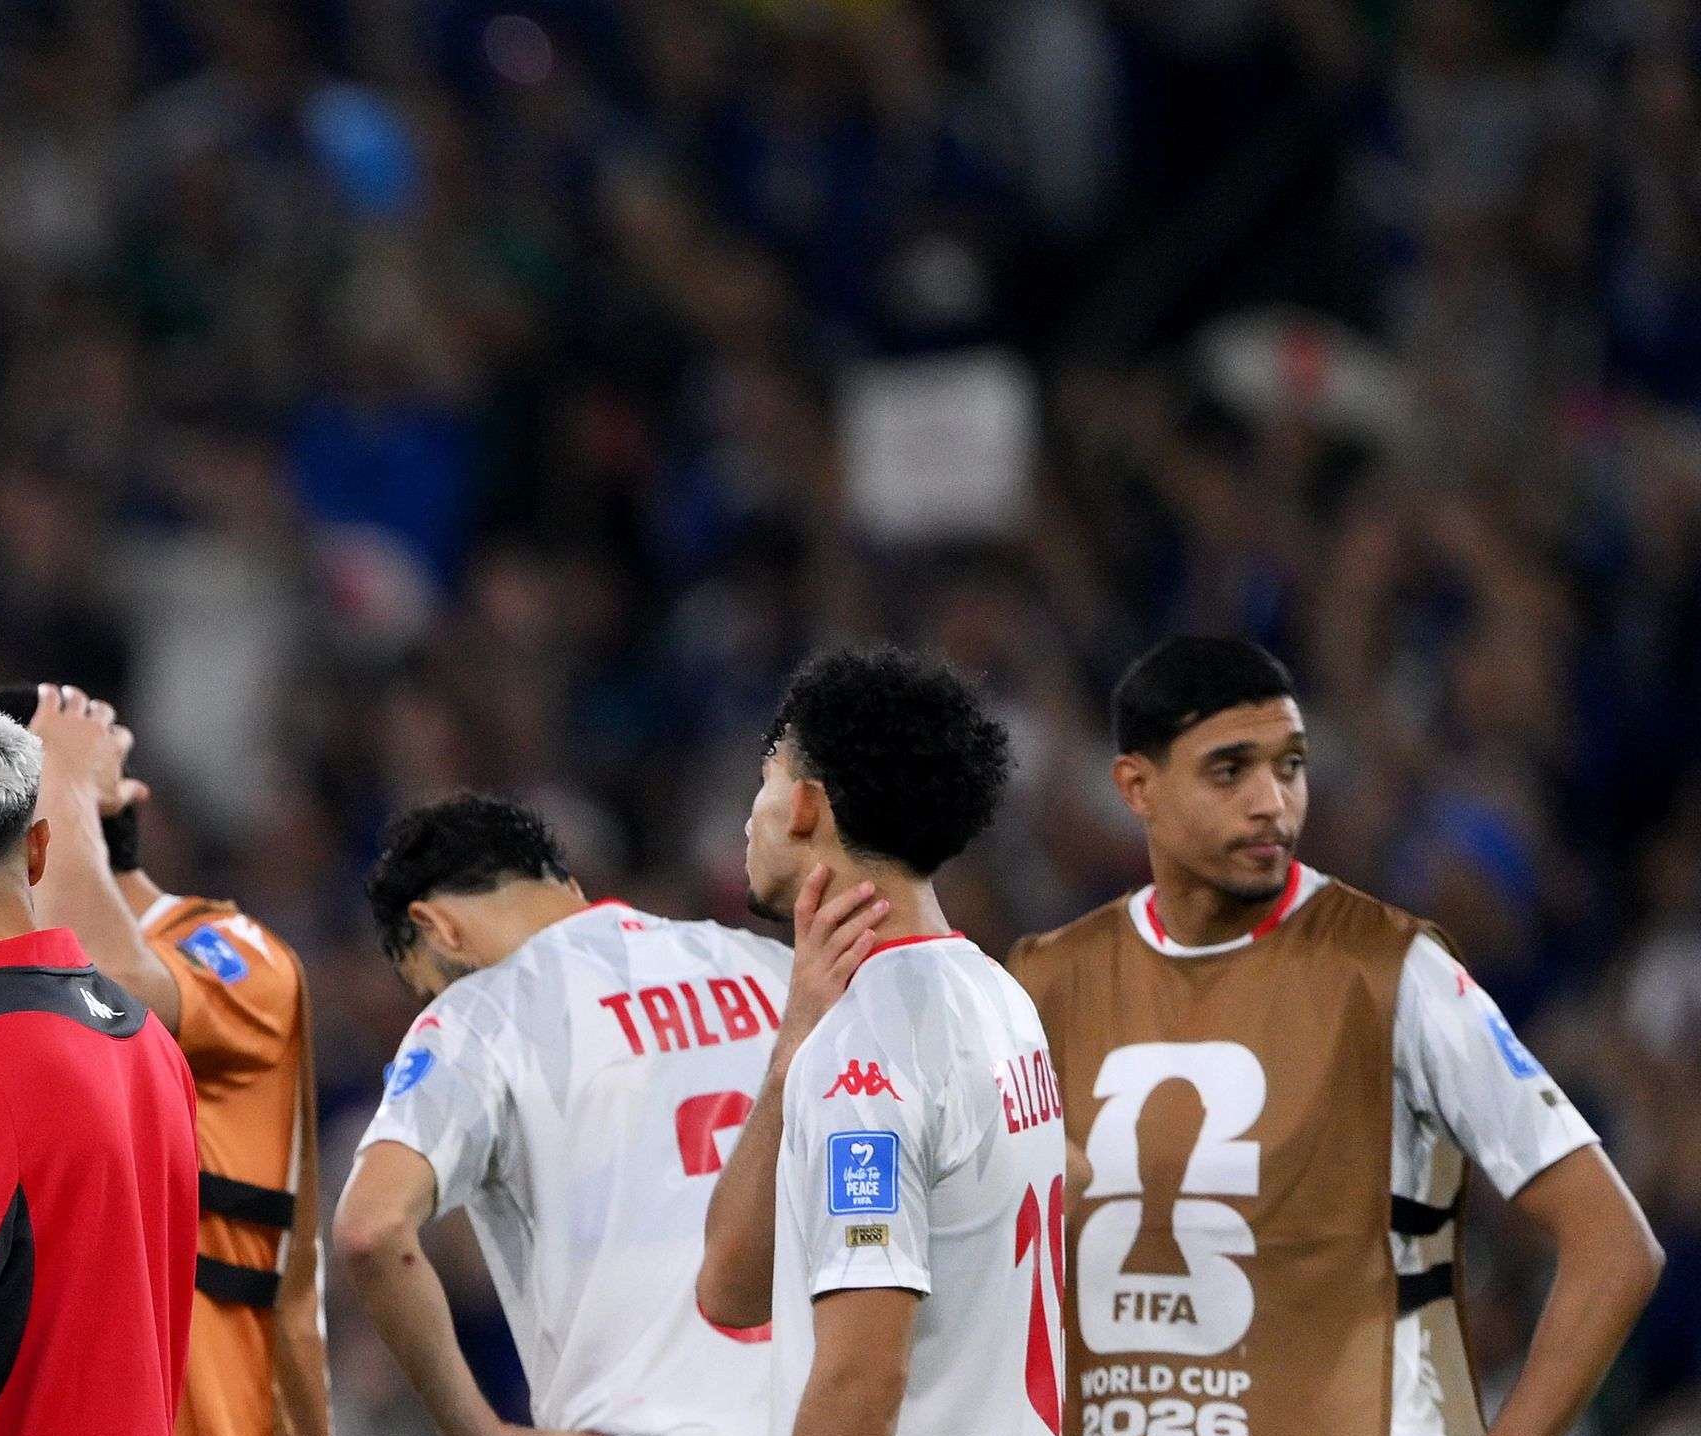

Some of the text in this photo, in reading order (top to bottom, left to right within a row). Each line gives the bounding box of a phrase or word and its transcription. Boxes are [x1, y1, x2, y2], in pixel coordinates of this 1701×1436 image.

[599, 975, 780, 1055] TALBI
[846, 1181, 880, 1197] PEACE
[1113, 1292, 1198, 1325] FIFA
[1180, 1366, 1251, 1398] CUP
